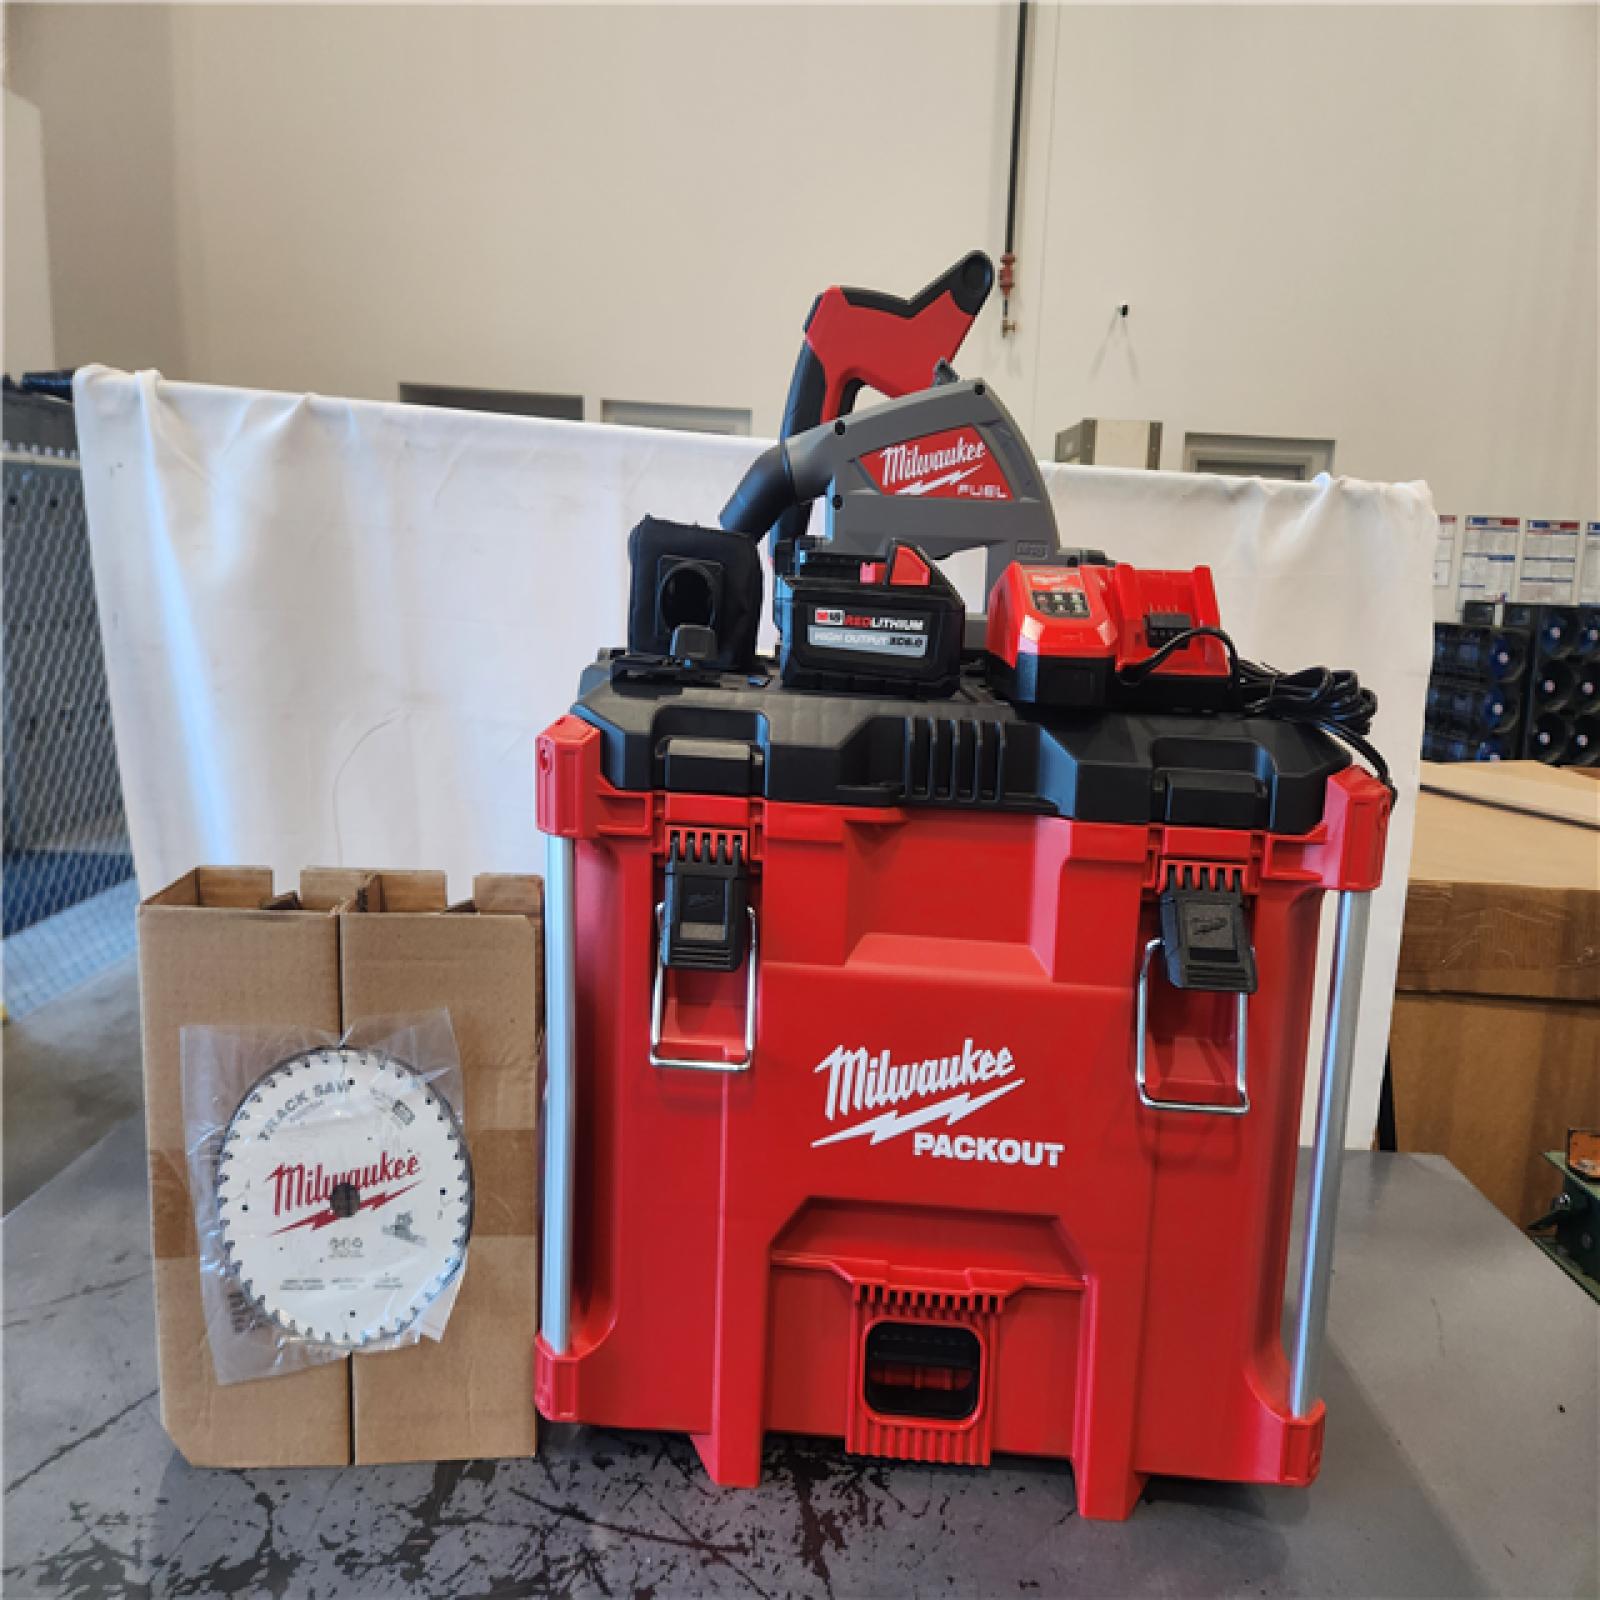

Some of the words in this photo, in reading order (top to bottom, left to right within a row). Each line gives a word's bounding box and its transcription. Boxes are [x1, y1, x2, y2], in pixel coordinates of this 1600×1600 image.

[879, 436, 985, 487] Milwaukee
[957, 484, 1008, 498] FUEL
[813, 1037, 1016, 1121] Milwaukee
[913, 1132, 1065, 1167] PACKOUT
